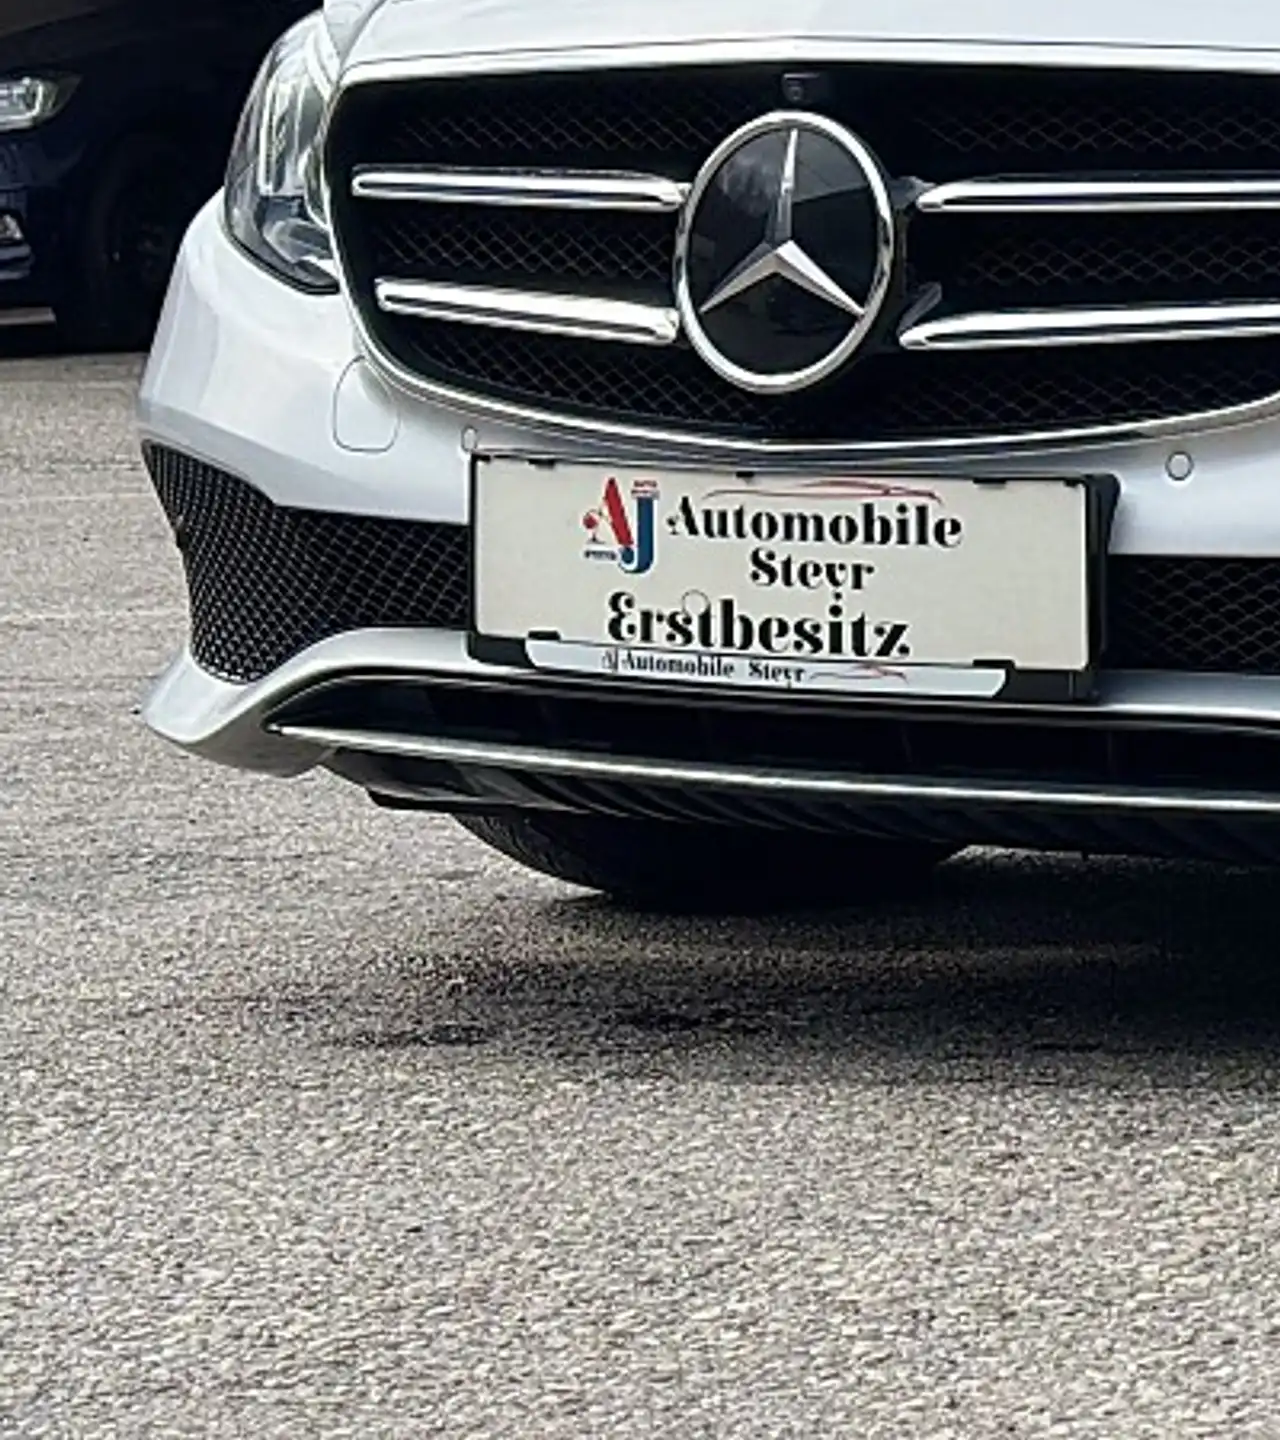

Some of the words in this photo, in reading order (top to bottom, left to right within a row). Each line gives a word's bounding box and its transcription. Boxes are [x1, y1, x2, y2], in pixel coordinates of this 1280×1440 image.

[666, 495, 963, 547] Automobile
[607, 589, 911, 657] Erstbesitz
[622, 650, 734, 677] Automobile
